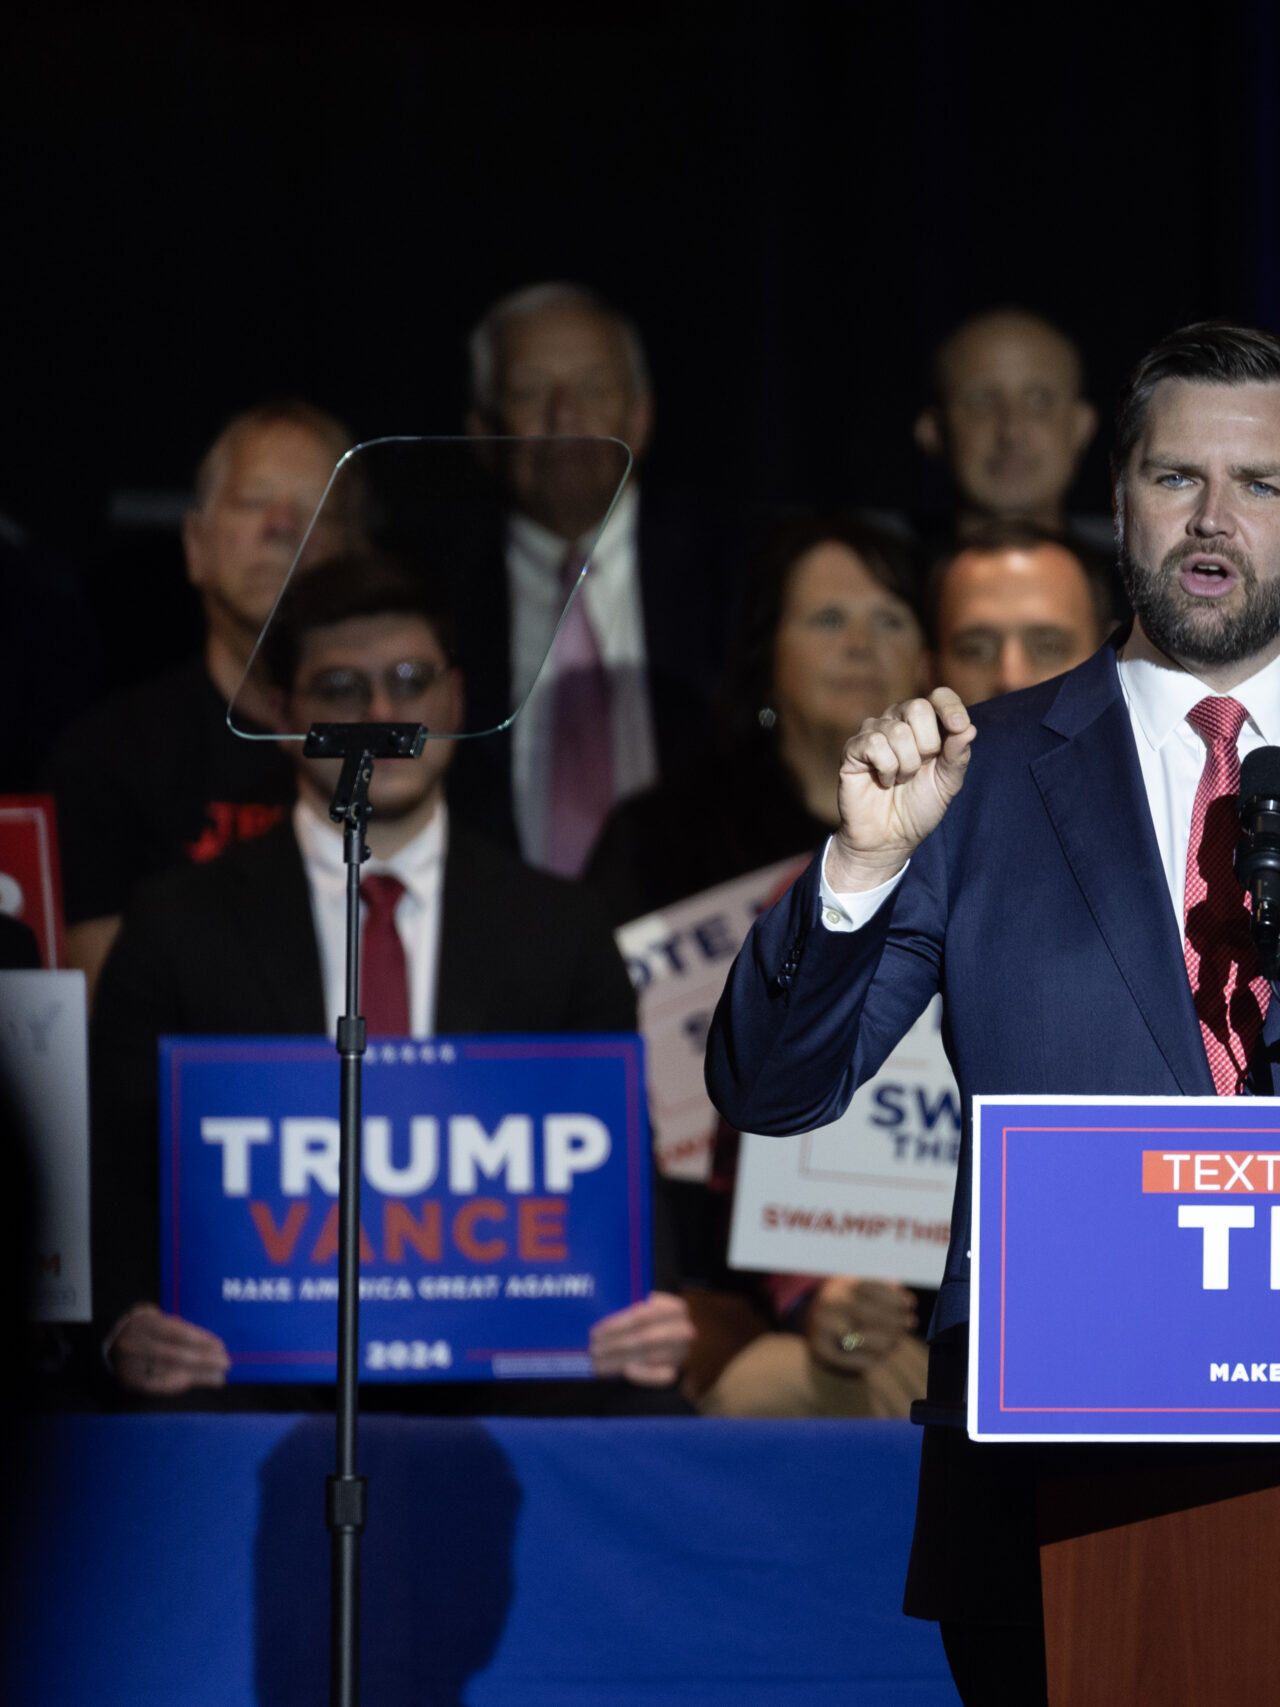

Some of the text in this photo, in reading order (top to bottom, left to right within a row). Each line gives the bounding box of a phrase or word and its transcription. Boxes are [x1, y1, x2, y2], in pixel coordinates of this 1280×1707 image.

[201, 1112, 612, 1196] TRUMP
[222, 1273, 595, 1302] MAKE AMRICA GREAT AGAIN!
[366, 1340, 452, 1371] 2024
